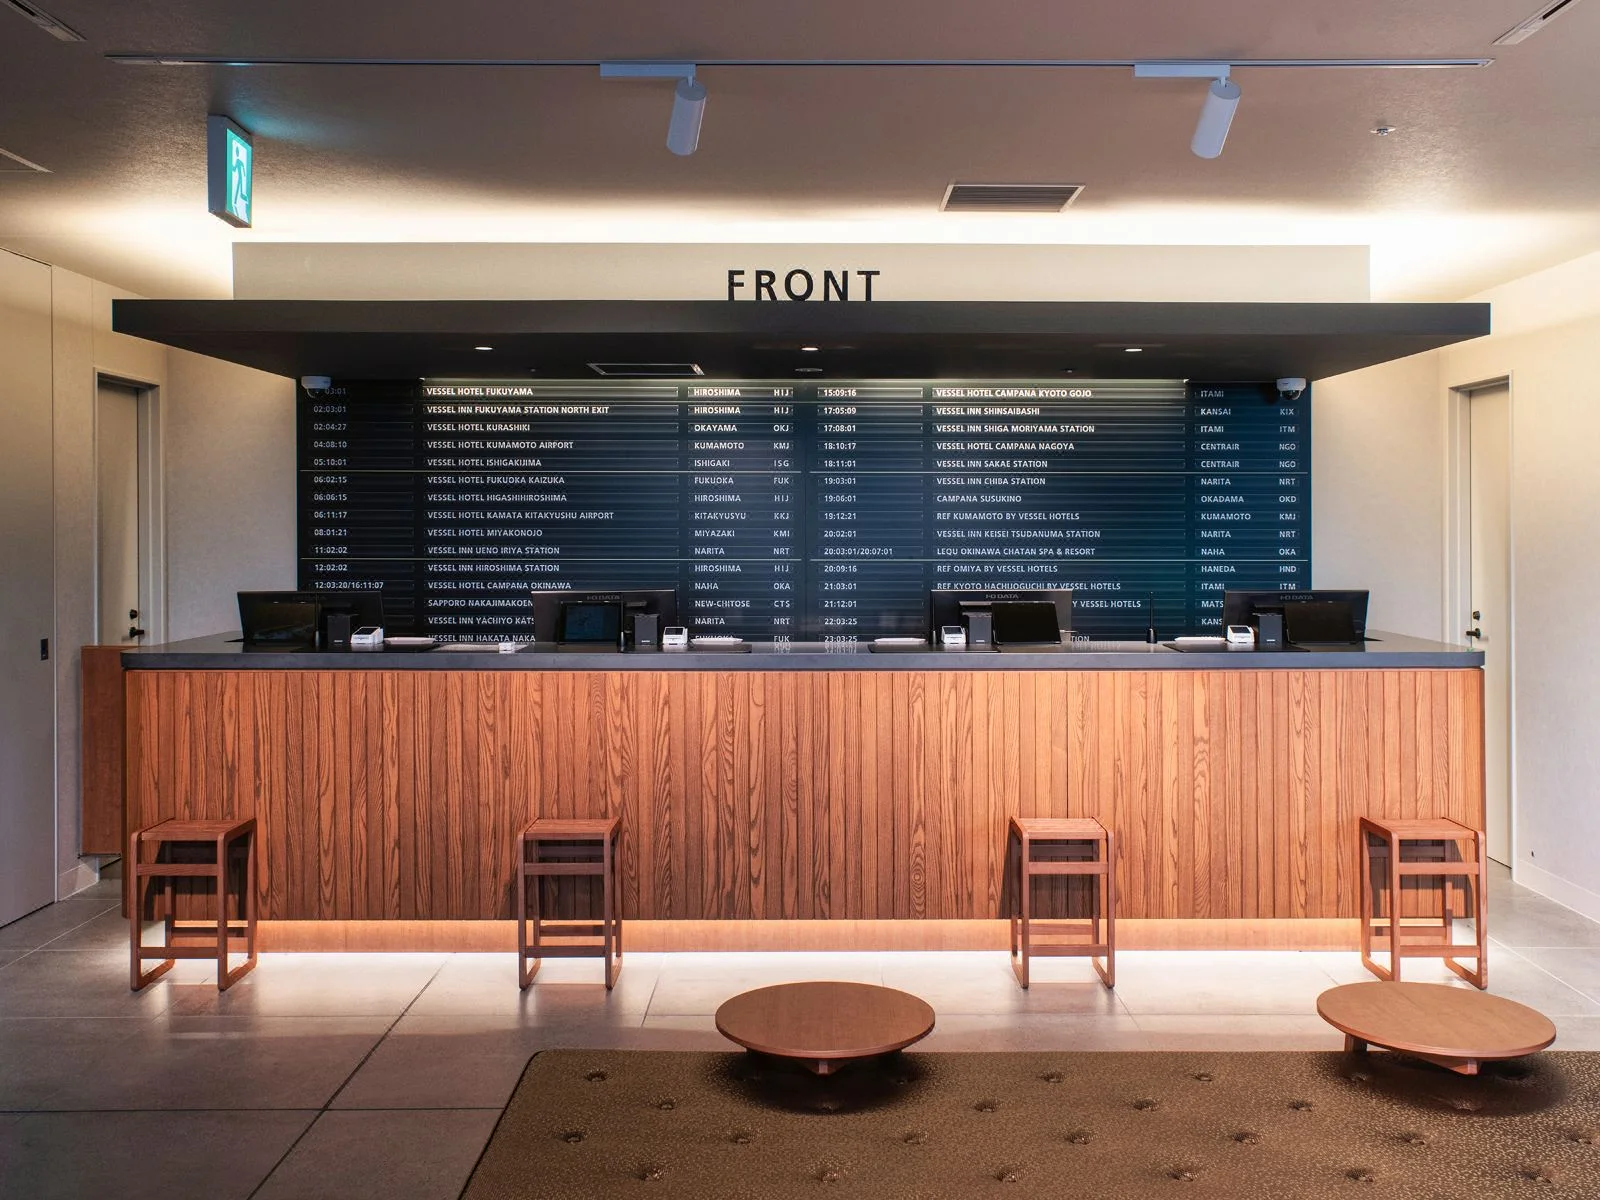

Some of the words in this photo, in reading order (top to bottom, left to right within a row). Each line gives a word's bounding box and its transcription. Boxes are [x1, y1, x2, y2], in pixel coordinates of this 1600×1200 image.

[728, 269, 881, 301] FRONT
[426, 387, 456, 395] VESSEL
[457, 387, 485, 396] HOTEL
[485, 387, 534, 396] FUKUYAMA
[693, 388, 741, 396] HIROSHIMA
[823, 389, 857, 397] 15:09:16
[935, 389, 966, 397] VESSEL
[966, 389, 994, 397] HOTEL
[994, 389, 1037, 397] CAMPANA
[1038, 389, 1068, 397] KYOTO
[1069, 389, 1092, 397] GOJO
[426, 406, 456, 414] VESSEL
[457, 406, 473, 414] INN
[474, 406, 522, 414] FUKUYAMA
[523, 406, 559, 414] STATION
[561, 406, 590, 414] NORTH
[591, 406, 610, 414] EXIT
[694, 406, 741, 414] HIROSHIMA
[823, 407, 857, 415] 17:05:09
[935, 407, 966, 415] VESSEL
[966, 407, 982, 415] INN
[983, 407, 1040, 415] SHINSAIBASHI
[1200, 408, 1231, 416] KANSAI
[427, 423, 457, 431] VESSEL
[458, 423, 485, 431] HOTEL
[486, 423, 530, 431] KURASHIKI
[694, 424, 738, 432] OKAYAMA
[773, 424, 789, 432] OKJ
[823, 424, 856, 432] 17:08:01
[936, 424, 966, 433] VESSEL
[983, 425, 1010, 433] SHIGA
[1060, 425, 1095, 433] STATION
[1200, 425, 1224, 433] ITAMI
[427, 441, 456, 449] VESSEL
[458, 441, 485, 449] HOTEL
[486, 441, 537, 449] KUMAMOTO
[538, 441, 574, 449] AIRPORT
[823, 442, 857, 450] 18:10:17
[936, 442, 966, 450] VESSEL
[967, 442, 994, 450] HOTEL
[995, 442, 1037, 450] CAMPANA
[1038, 442, 1075, 450] NAGOYA
[427, 458, 456, 466] VESSEL
[458, 458, 485, 466] HOTEL
[694, 459, 730, 467] ISHIGAKI
[936, 460, 966, 468] VESSEL
[967, 460, 982, 468] INN
[983, 460, 1011, 468] SAKAE
[1012, 460, 1048, 468] STATION
[1200, 460, 1240, 468] CENTRAIR
[427, 476, 456, 484] VESSEL
[458, 476, 485, 484] HOTEL
[486, 476, 527, 484] FUKUOKA
[528, 476, 565, 484] KAIZUKA
[694, 476, 734, 484] FUKUOKA
[773, 477, 790, 485] FUK
[824, 477, 856, 485] 19:03:01
[936, 477, 966, 485] VESSEL
[967, 477, 982, 485] INN
[984, 477, 1009, 485] CHIBA
[1010, 477, 1046, 485] STATION
[458, 494, 485, 502] HOTEL
[486, 494, 567, 502] HIGASHIHIROSHIMA
[694, 494, 742, 502] HIROSHIMA
[824, 494, 857, 502] 19:06:01
[980, 495, 1022, 503] SUSUKINO
[1200, 495, 1245, 503] OKADAMA
[1278, 495, 1297, 503] OKD
[694, 512, 747, 520] KITAKYUSYU
[824, 512, 857, 520] 19:12:21
[936, 512, 952, 520] REF
[953, 512, 1004, 520] KUMAMOTO
[1005, 512, 1017, 520] BY
[1018, 512, 1048, 520] VESSEL
[1049, 512, 1080, 520] HOTELS
[427, 529, 457, 537] VESSEL
[458, 529, 485, 537] HOTEL
[486, 529, 543, 537] MIYAKONOJO
[823, 530, 857, 538] 20:02:01
[936, 530, 966, 538] VESSEL
[967, 530, 982, 538] INN
[984, 530, 1009, 538] KEISEI
[1010, 530, 1064, 538] TSUDANUMA
[1065, 530, 1101, 538] STATION
[1201, 530, 1232, 538] NARITA
[1279, 530, 1296, 538] NRT
[427, 546, 457, 554] VESSEL
[458, 546, 473, 554] INN
[475, 546, 499, 554] UENO
[524, 546, 560, 554] STATION
[694, 547, 725, 555] NARITA
[773, 547, 790, 555] NRT
[936, 547, 959, 555] LEQU
[1056, 548, 1063, 556] &
[1201, 548, 1226, 556] NAHA
[1278, 548, 1297, 556] OKA
[427, 564, 457, 572] VESSEL
[458, 564, 474, 572] INN
[475, 564, 523, 572] HIROSHIMA
[524, 564, 560, 572] STATION
[694, 564, 742, 572] HIROSHIMA
[824, 565, 858, 573] 20:09:16
[936, 565, 952, 573] REF
[983, 565, 995, 573] BY
[996, 565, 1026, 573] VESSEL
[1027, 565, 1058, 573] HOTELS
[1201, 565, 1236, 573] HANEDA
[427, 581, 457, 589] VESSEL
[458, 581, 485, 589] HOTEL
[694, 582, 719, 590] NAHA
[773, 582, 791, 590] OKA
[824, 582, 857, 590] 21:03:01
[694, 600, 751, 608] NEW-CHITOSE
[824, 600, 857, 608] 21:12:01
[694, 617, 726, 625] NARITA
[773, 617, 791, 625] NRT
[824, 617, 858, 625] 22:03:25
[824, 635, 858, 643] 23:03:25
